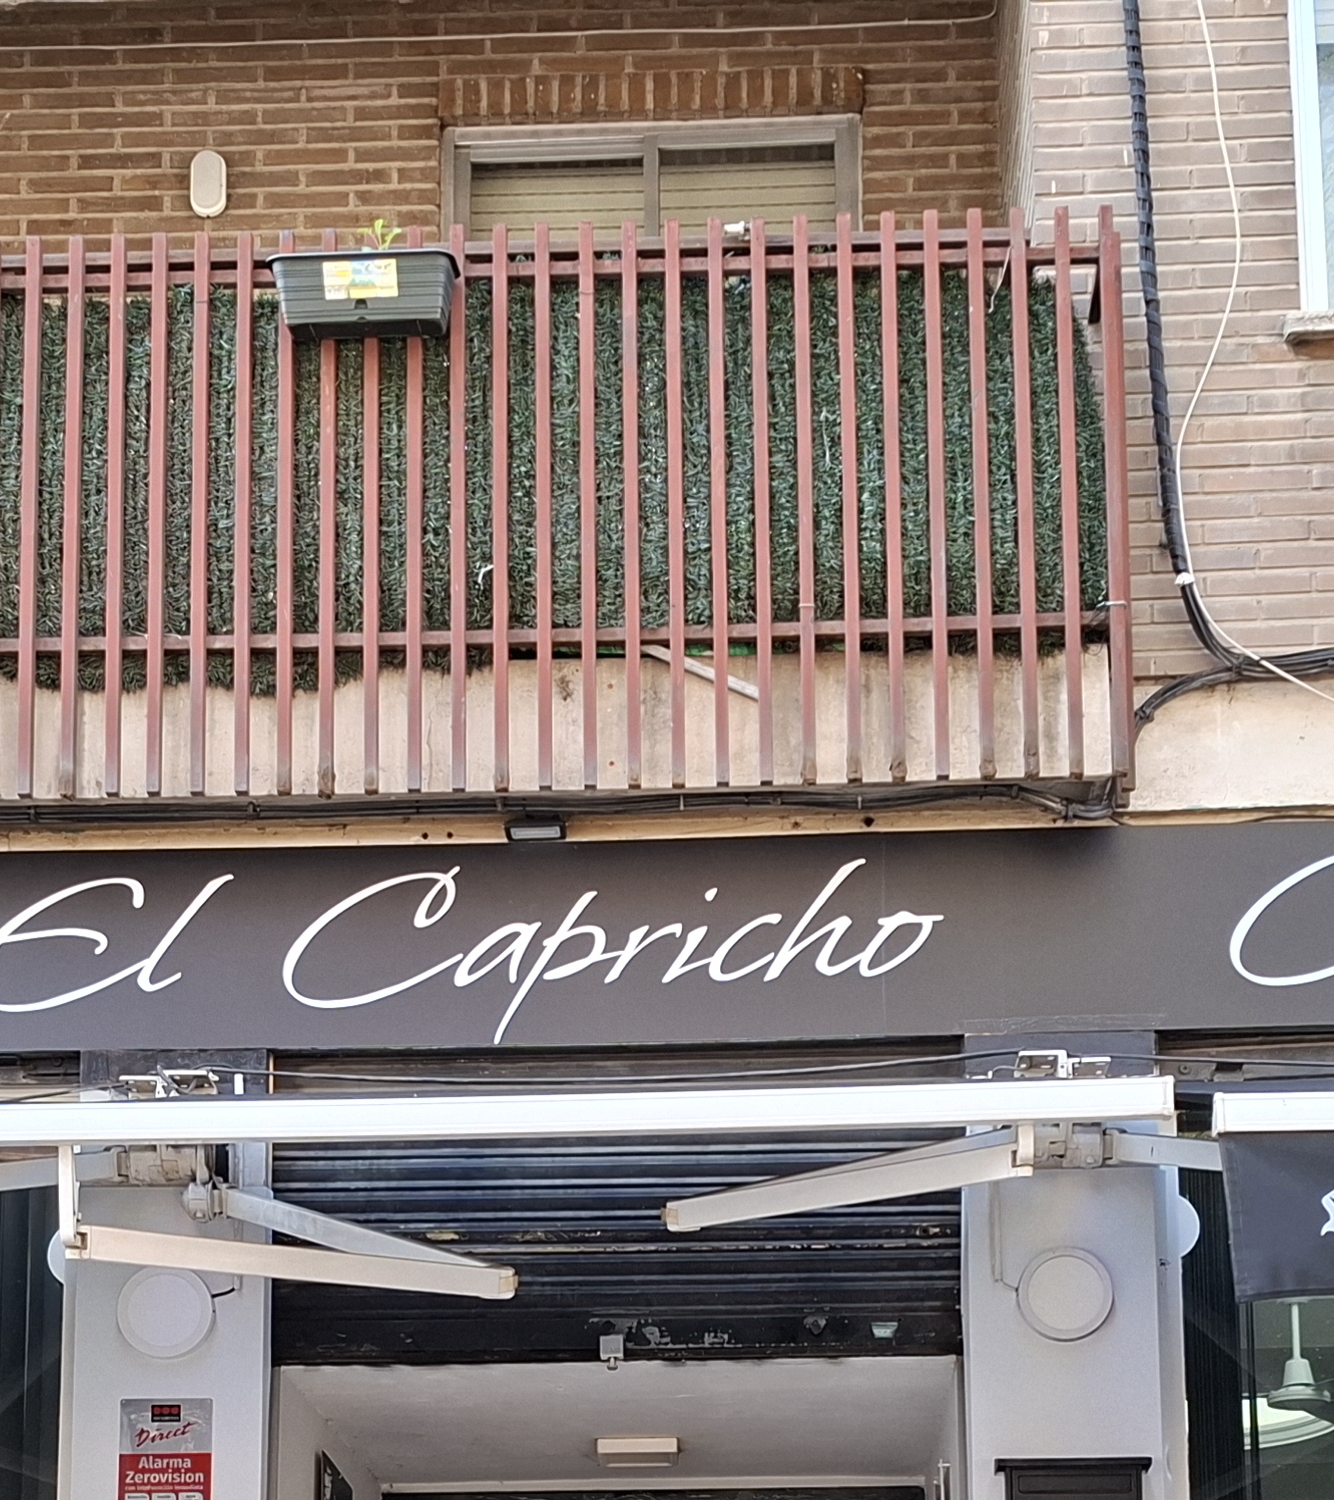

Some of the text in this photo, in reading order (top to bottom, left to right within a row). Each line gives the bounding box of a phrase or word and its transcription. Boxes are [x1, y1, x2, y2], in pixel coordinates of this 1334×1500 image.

[281, 858, 945, 1045] Capricho
[135, 1421, 198, 1447] Direct
[138, 1456, 192, 1469] Alarma
[125, 1468, 204, 1483] Zerovision
